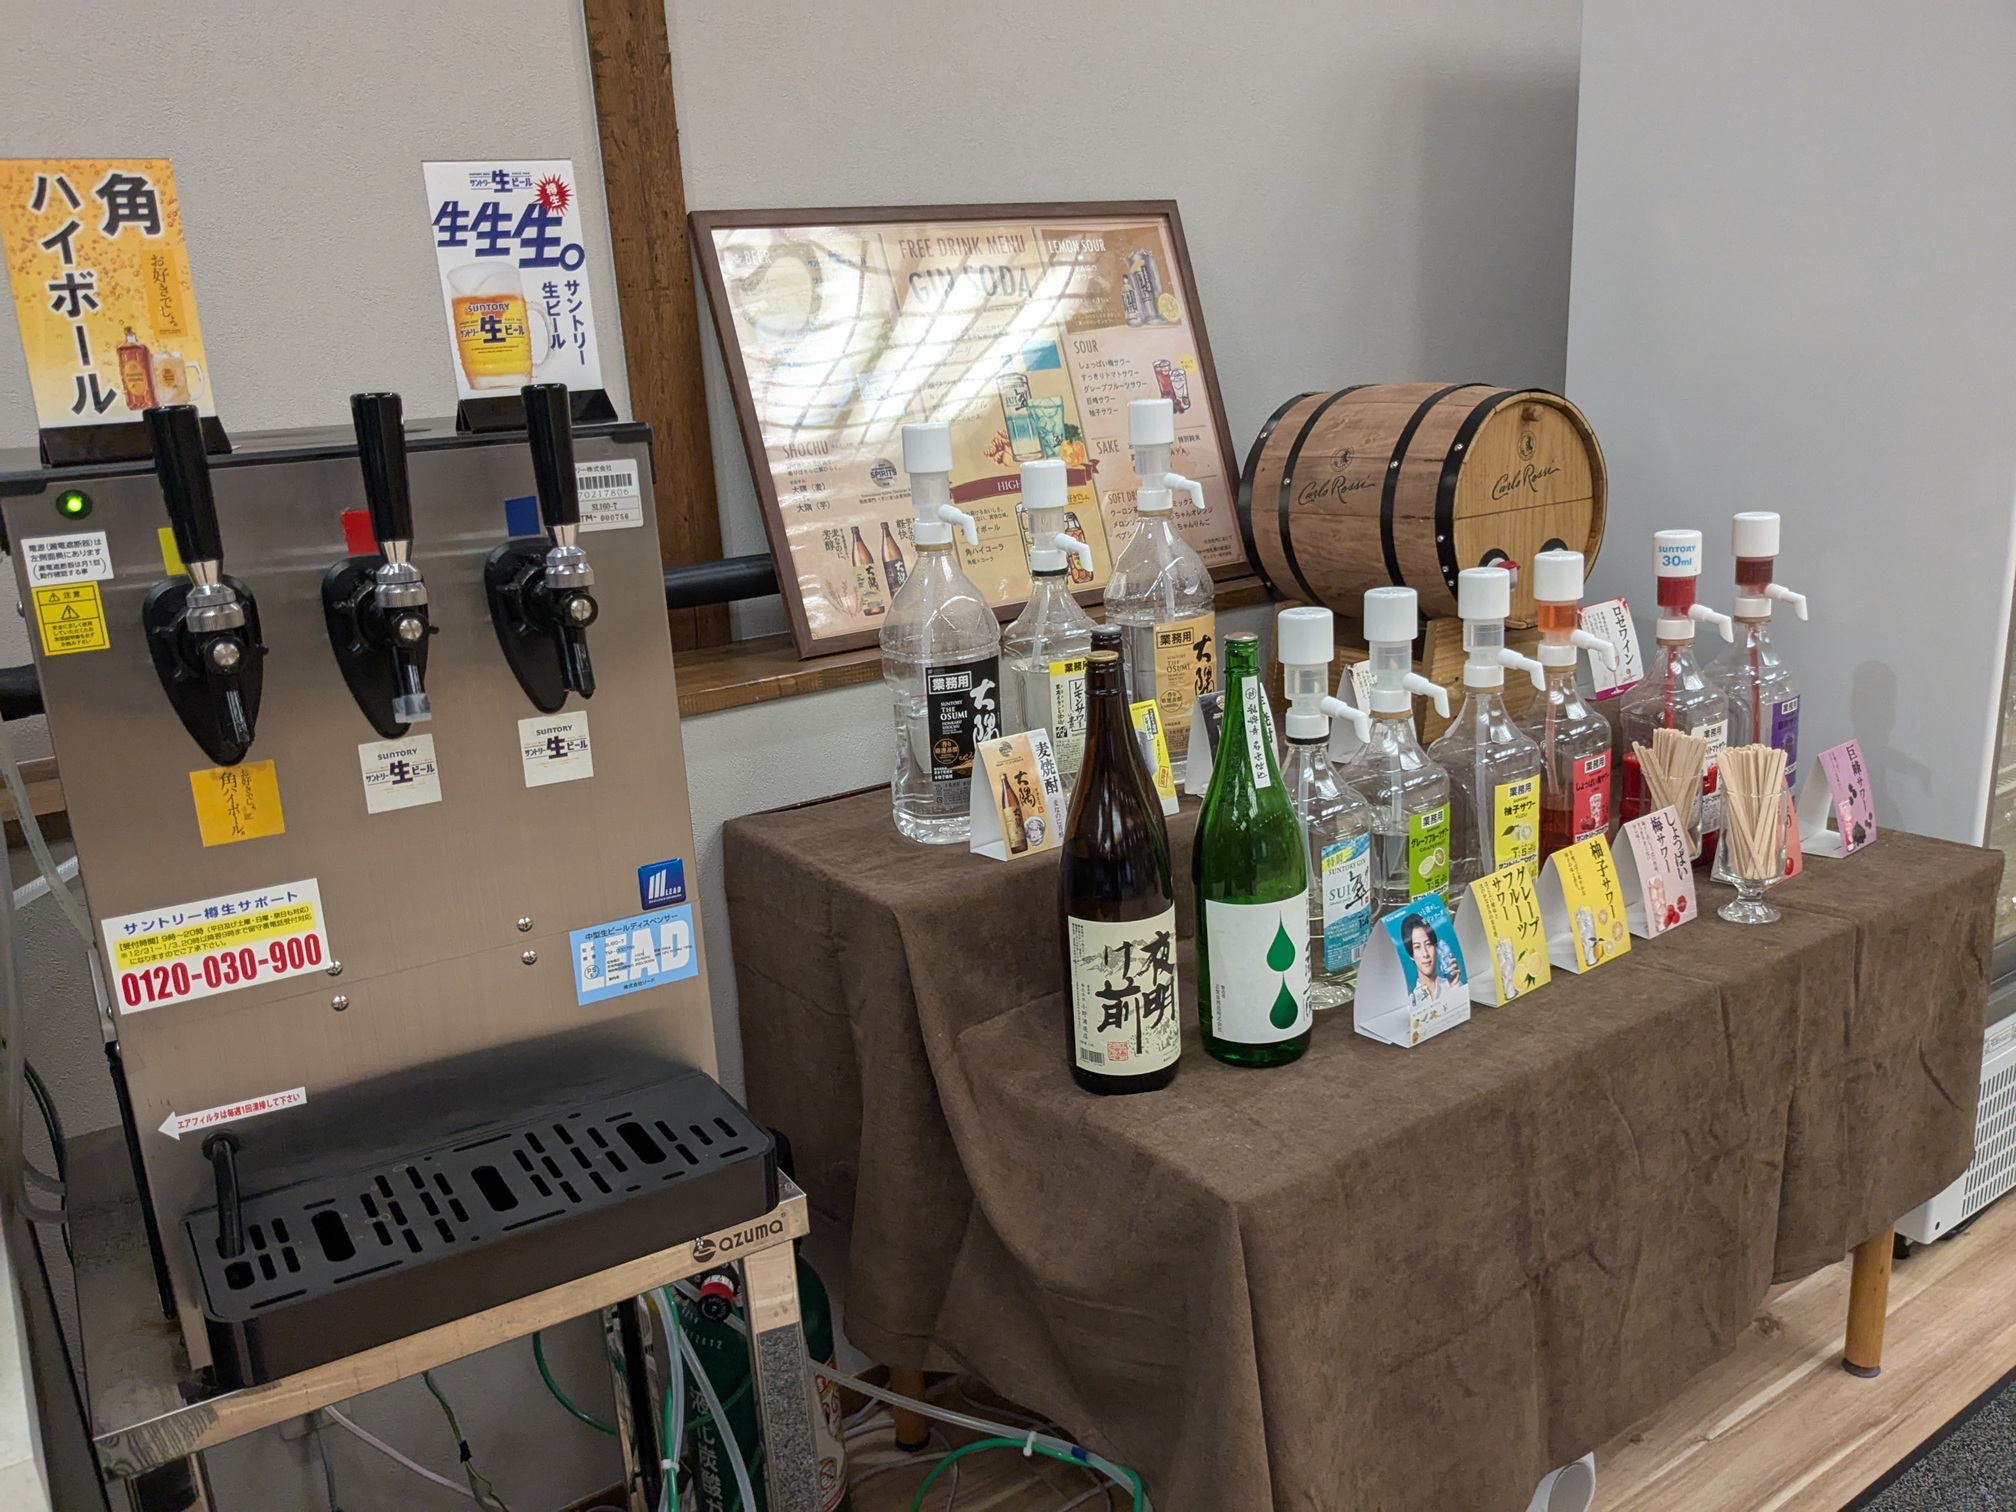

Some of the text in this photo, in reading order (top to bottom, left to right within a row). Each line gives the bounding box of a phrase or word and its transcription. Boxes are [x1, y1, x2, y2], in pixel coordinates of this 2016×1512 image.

[95, 173, 162, 236] 角
[898, 234, 1026, 259] FREE DRINK MENU
[1048, 239, 1106, 254] LEMON SOUR
[908, 266, 955, 304] GIN
[31, 175, 118, 416] ハイボール
[541, 281, 567, 350] 生ビール
[564, 280, 587, 366] サントリー
[1074, 340, 1099, 354] SOUR
[782, 440, 829, 459] SHOCHU
[1096, 440, 1120, 454] SAKE
[870, 469, 897, 479] SPIRITS
[1108, 491, 1126, 505] SOFT
[965, 543, 1004, 556] 角ハイコーラ
[1658, 545, 1696, 553] SUNTORY
[1662, 555, 1692, 567] 30ml
[1160, 631, 1192, 646] 業務用
[1612, 606, 1634, 666] ロゼワイン
[1166, 664, 1191, 674] OSUMI
[932, 675, 969, 691] 業務用
[940, 710, 968, 721] OSUMI
[536, 724, 573, 736] SUNTORY
[1704, 726, 1722, 738] 業務用
[377, 748, 418, 760] SUNTORY
[1035, 741, 1059, 795] 麦焼酎
[1846, 743, 1867, 812] 巨峰サワー
[1509, 782, 1532, 797] 業務用
[1503, 801, 1536, 816] 柚子サワー
[1423, 811, 1443, 827] 業務用
[1650, 816, 1671, 873] 梅サワー
[1663, 812, 1688, 881] しょっぱい
[1326, 852, 1344, 868] 特製
[1328, 861, 1356, 876] SUNTORY
[1589, 841, 1616, 919] 柚子サワー
[665, 886, 682, 896] LEAD
[1329, 884, 1351, 901] SUI
[123, 891, 298, 935] サントリー樽生サポート
[585, 914, 679, 940] 中型生ビールディスペンサー
[580, 919, 690, 992] LEAD
[121, 933, 322, 1006] 0120-030-900
[178, 1093, 300, 1129] エアフィルタは毎週1回清掃して下さい
[719, 1219, 784, 1252] azuma
